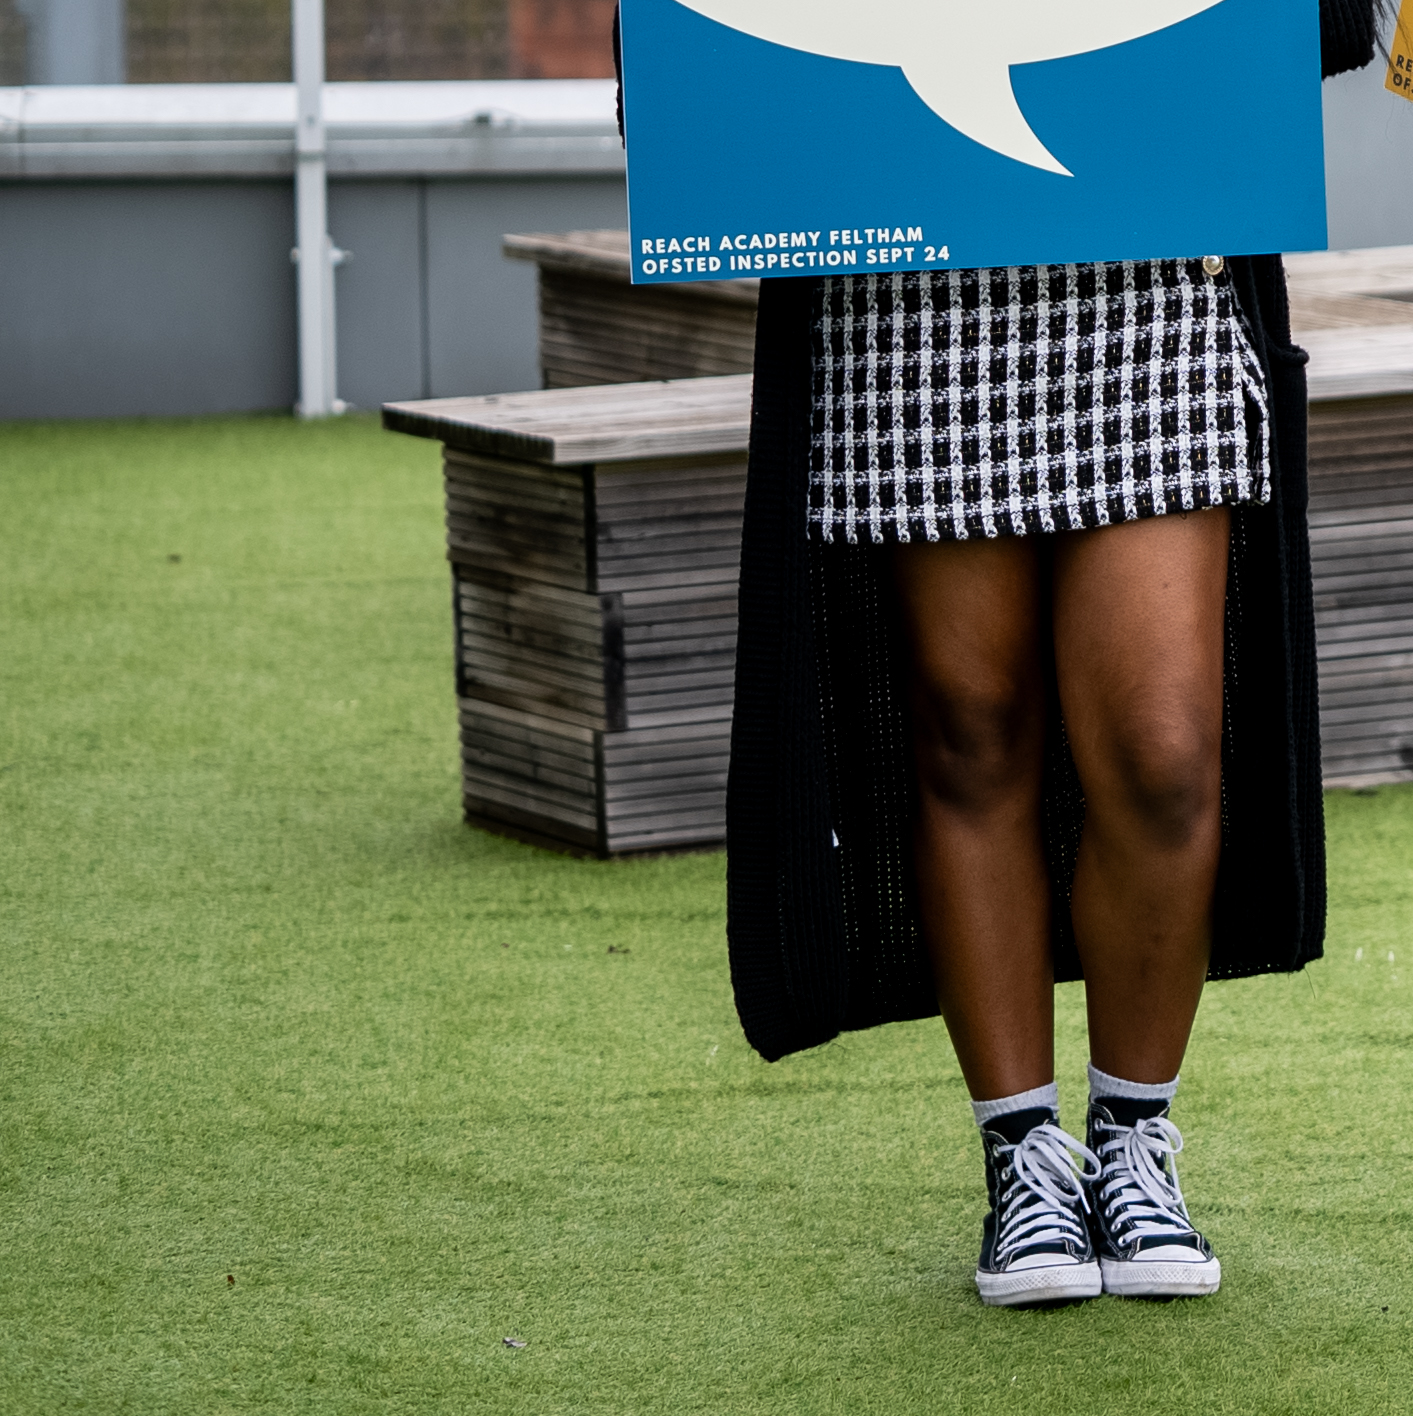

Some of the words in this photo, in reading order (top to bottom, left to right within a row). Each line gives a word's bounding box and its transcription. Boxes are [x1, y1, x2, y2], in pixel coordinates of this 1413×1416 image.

[641, 236, 711, 255] REACH
[718, 231, 821, 251] ACADEMY
[829, 226, 923, 246] FELTHAM
[642, 256, 722, 275] OFSTED
[729, 249, 857, 271] INSPECTION
[866, 246, 915, 265] SEPT
[923, 245, 950, 262] 24
